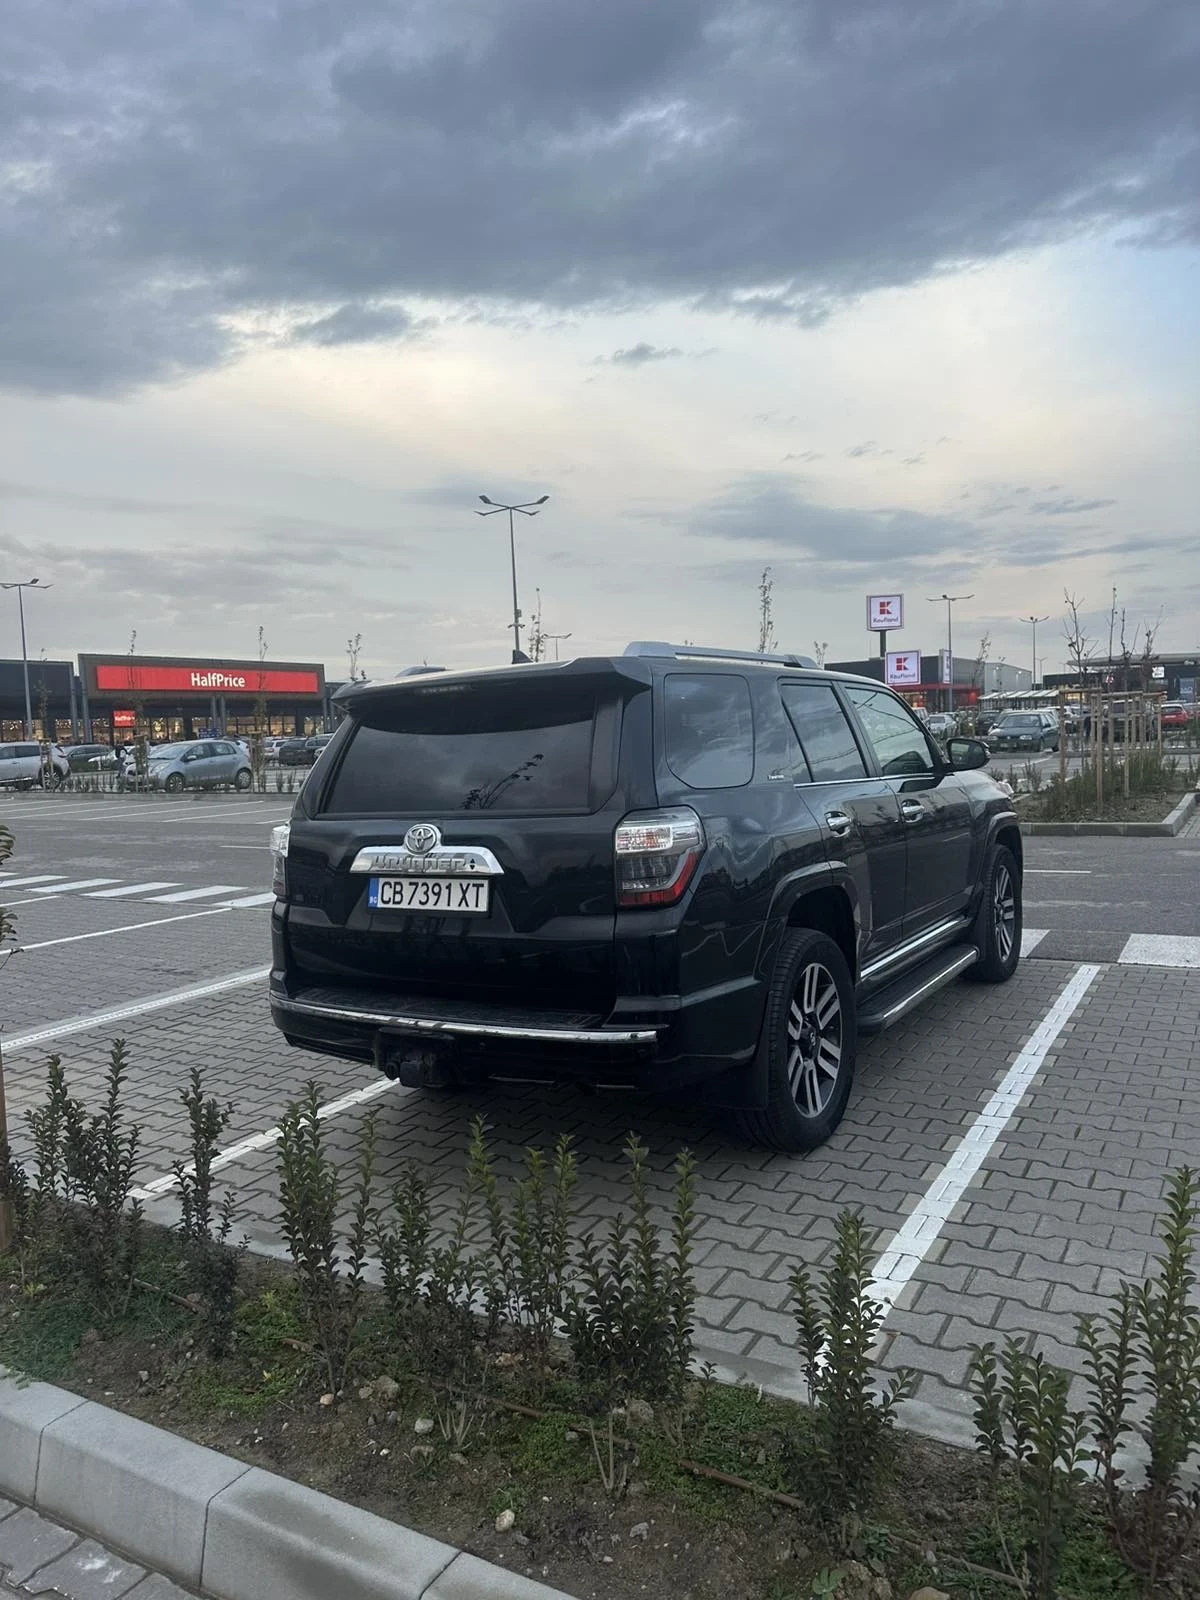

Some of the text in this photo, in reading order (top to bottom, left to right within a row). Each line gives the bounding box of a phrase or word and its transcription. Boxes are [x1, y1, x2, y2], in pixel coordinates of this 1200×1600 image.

[191, 672, 246, 688] HalfPrice
[380, 881, 485, 908] CB 7391 XT
